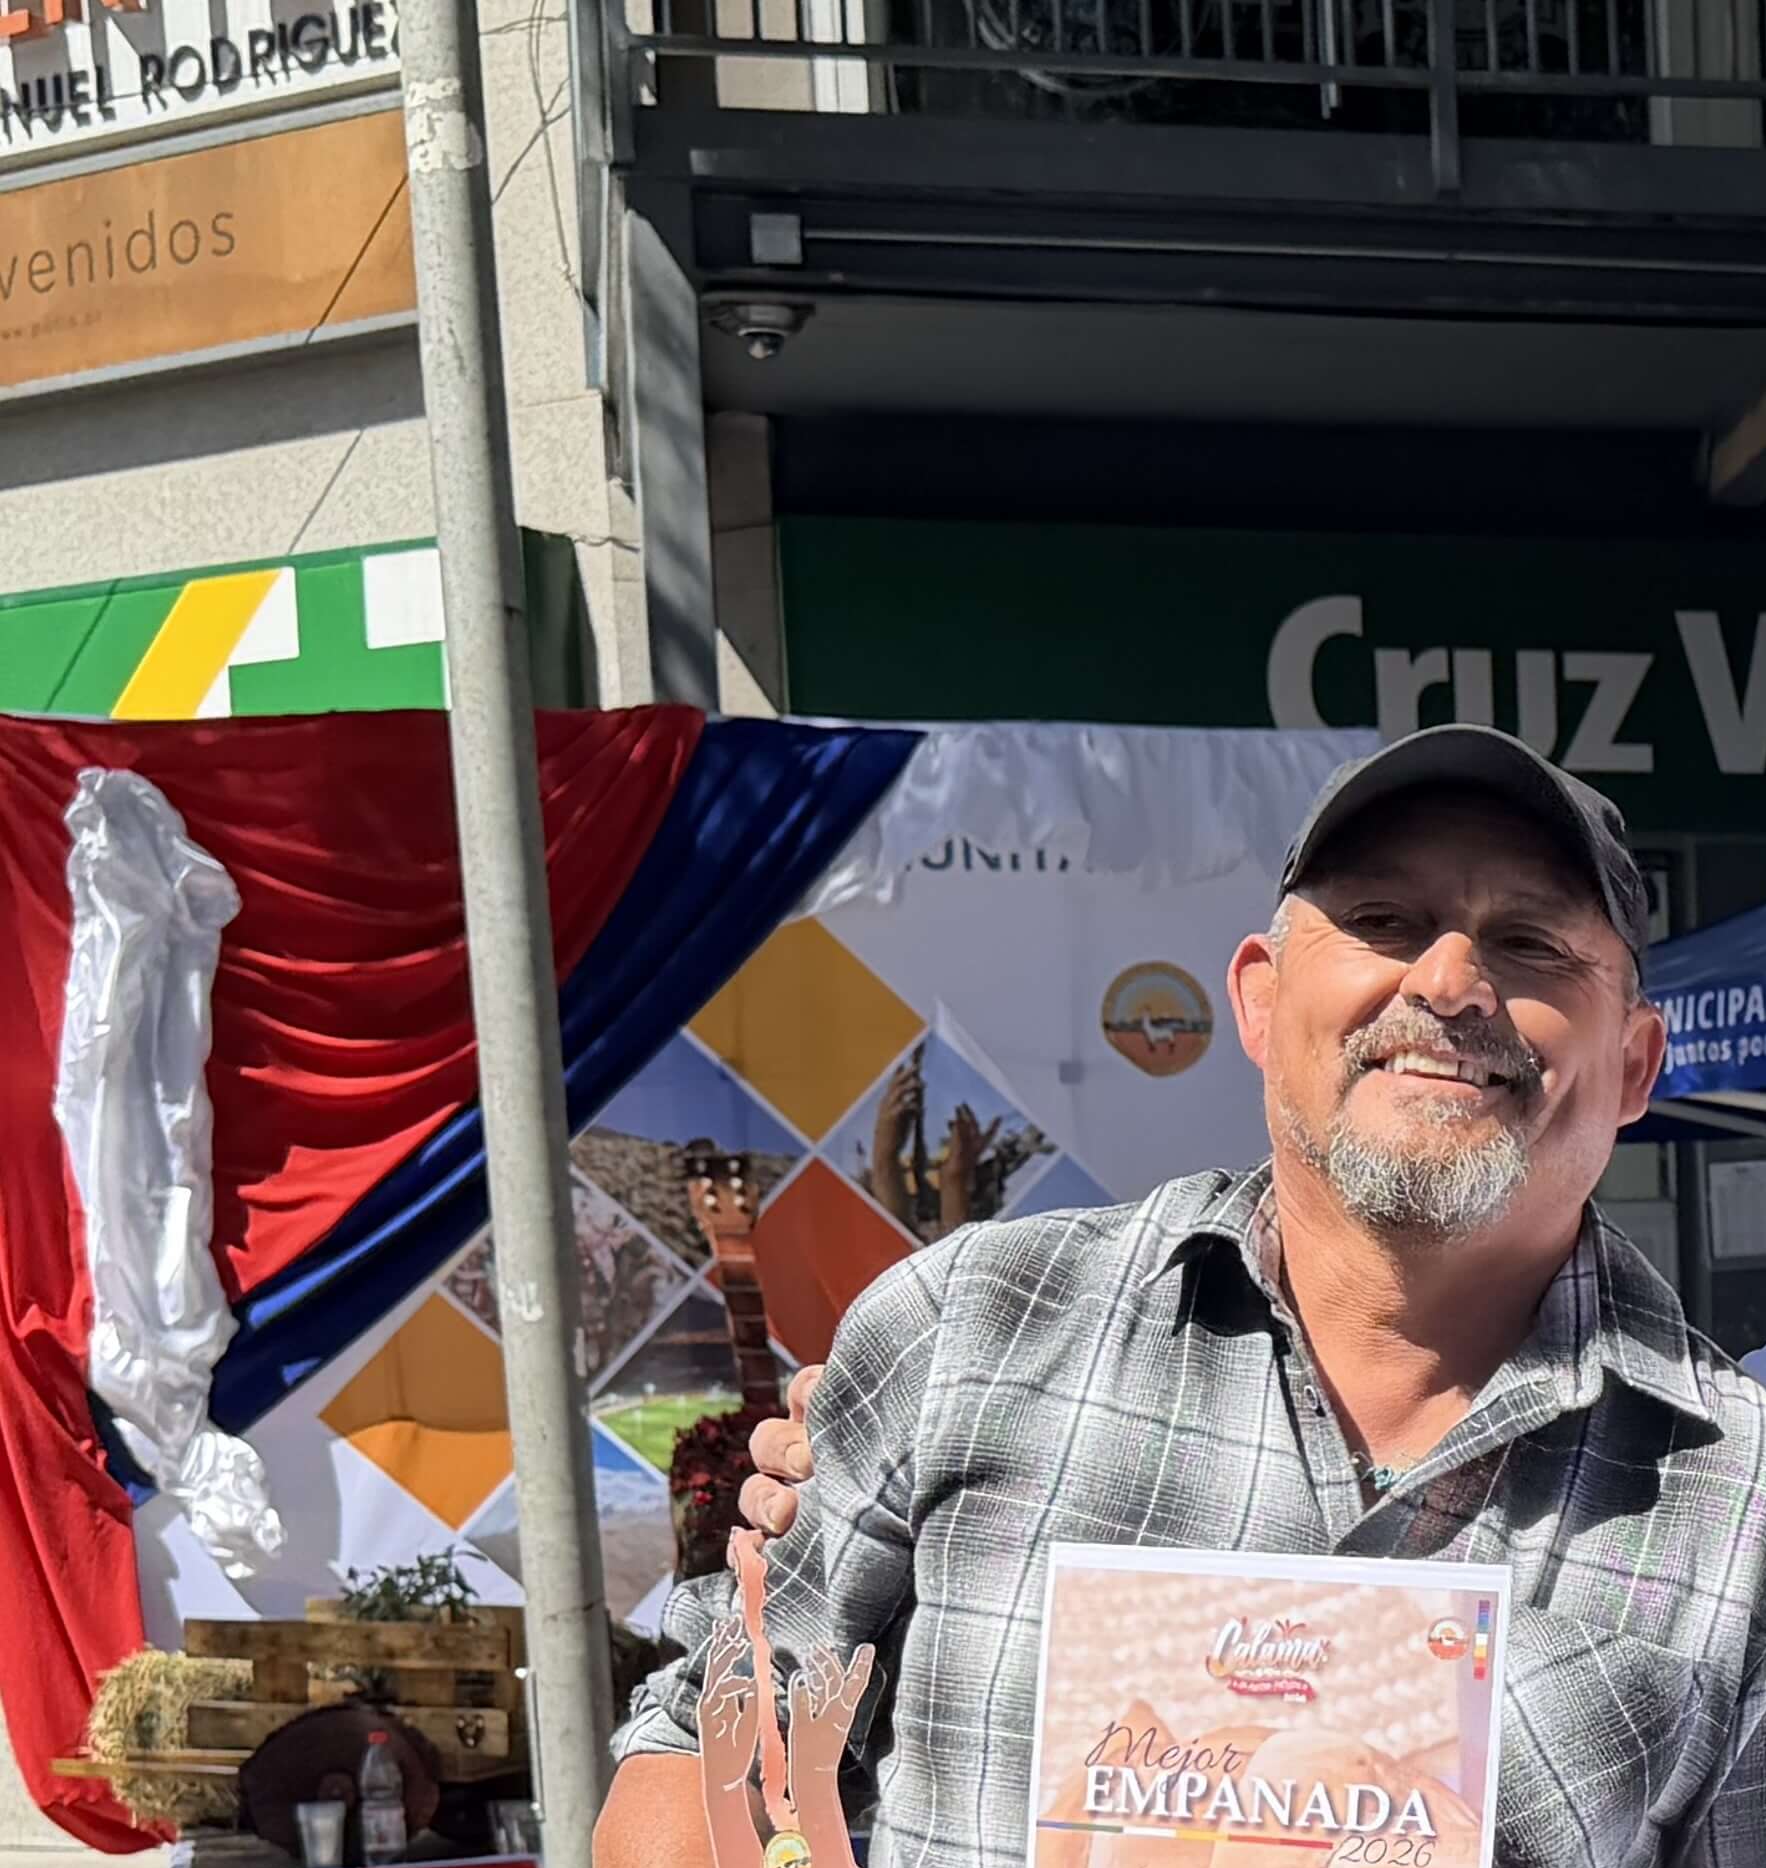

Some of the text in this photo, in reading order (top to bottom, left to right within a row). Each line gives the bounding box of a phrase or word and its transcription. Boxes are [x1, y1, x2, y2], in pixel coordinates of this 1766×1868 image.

[1265, 595, 1654, 773] Cruz
[1084, 1720, 1250, 1794] Mejor
[1082, 1764, 1438, 1838] EMPANADA
[1338, 1836, 1436, 1868] 2026
